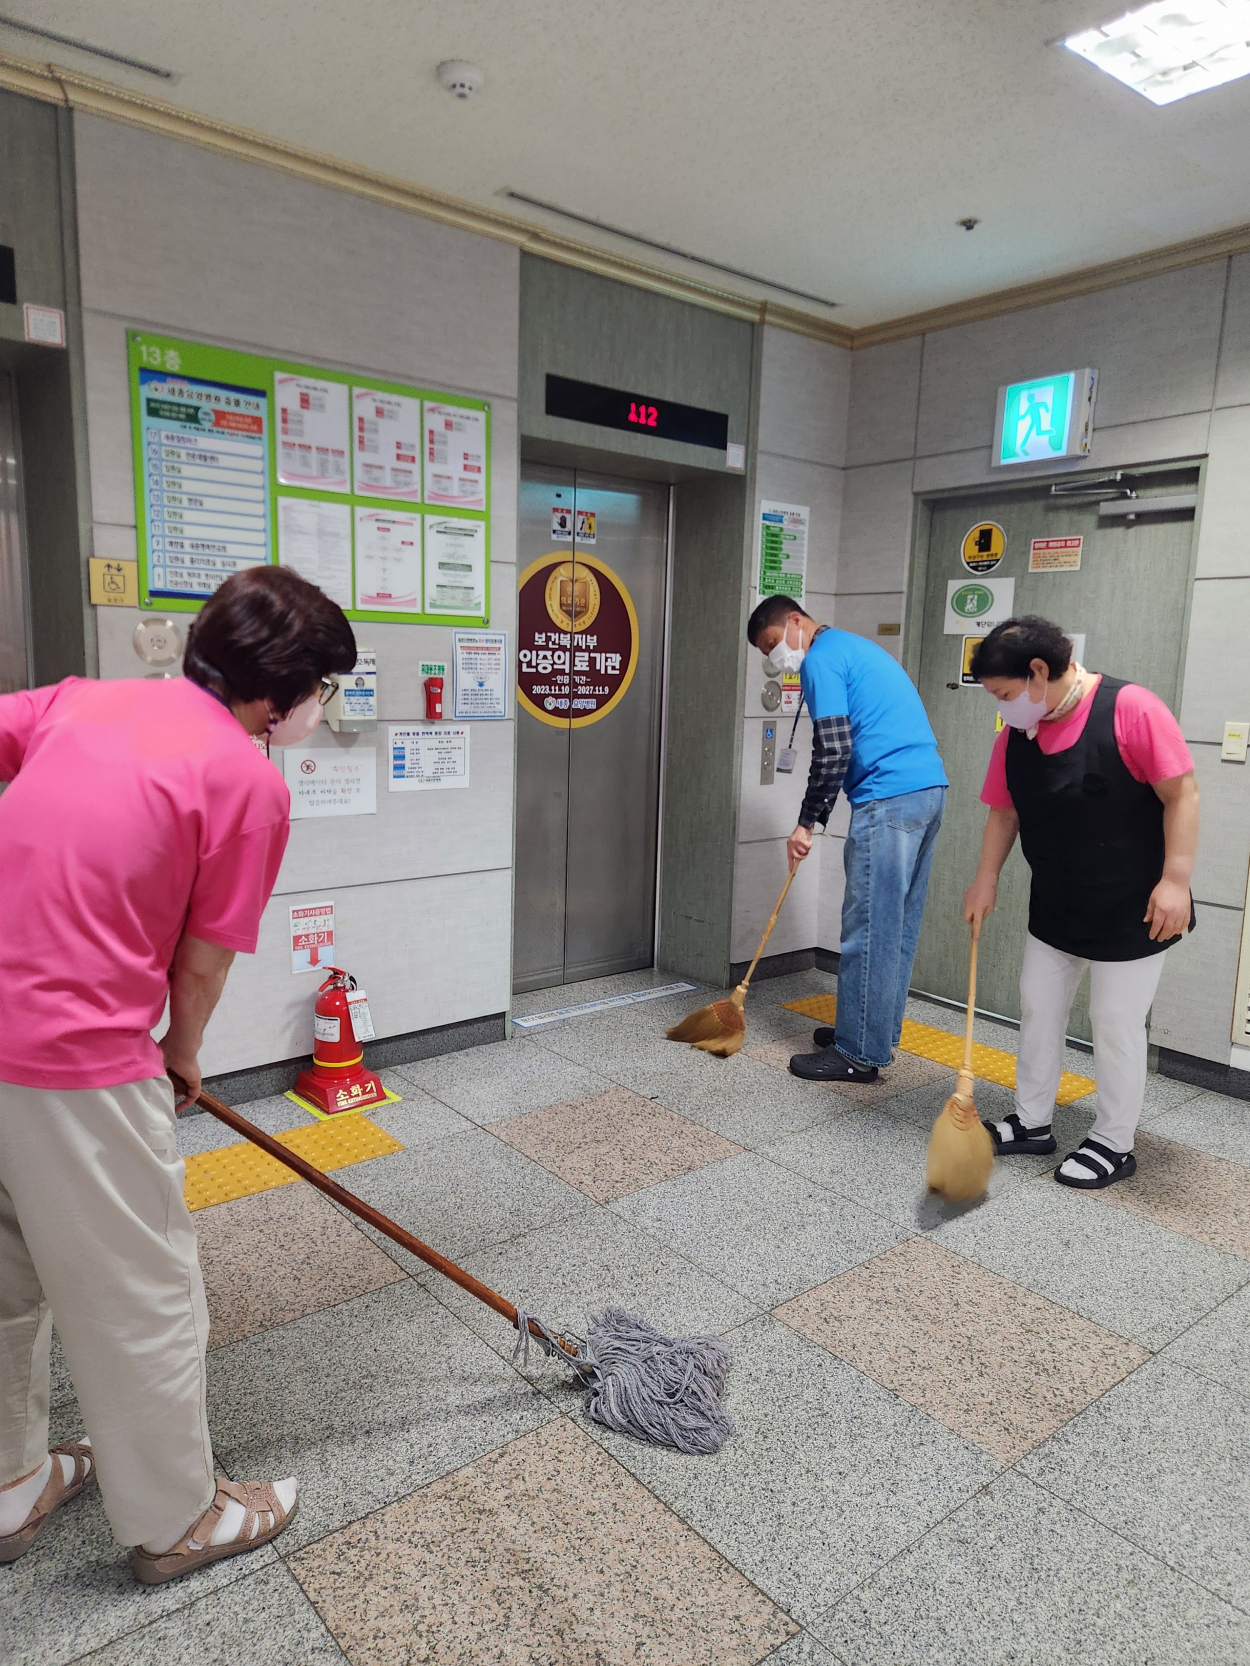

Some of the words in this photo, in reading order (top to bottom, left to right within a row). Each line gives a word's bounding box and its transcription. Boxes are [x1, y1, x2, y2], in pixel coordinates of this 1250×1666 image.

[140, 344, 181, 371] 13층
[518, 650, 622, 675] 인증의료기관
[298, 931, 327, 946] 소화기
[336, 1080, 377, 1101] 소화기
